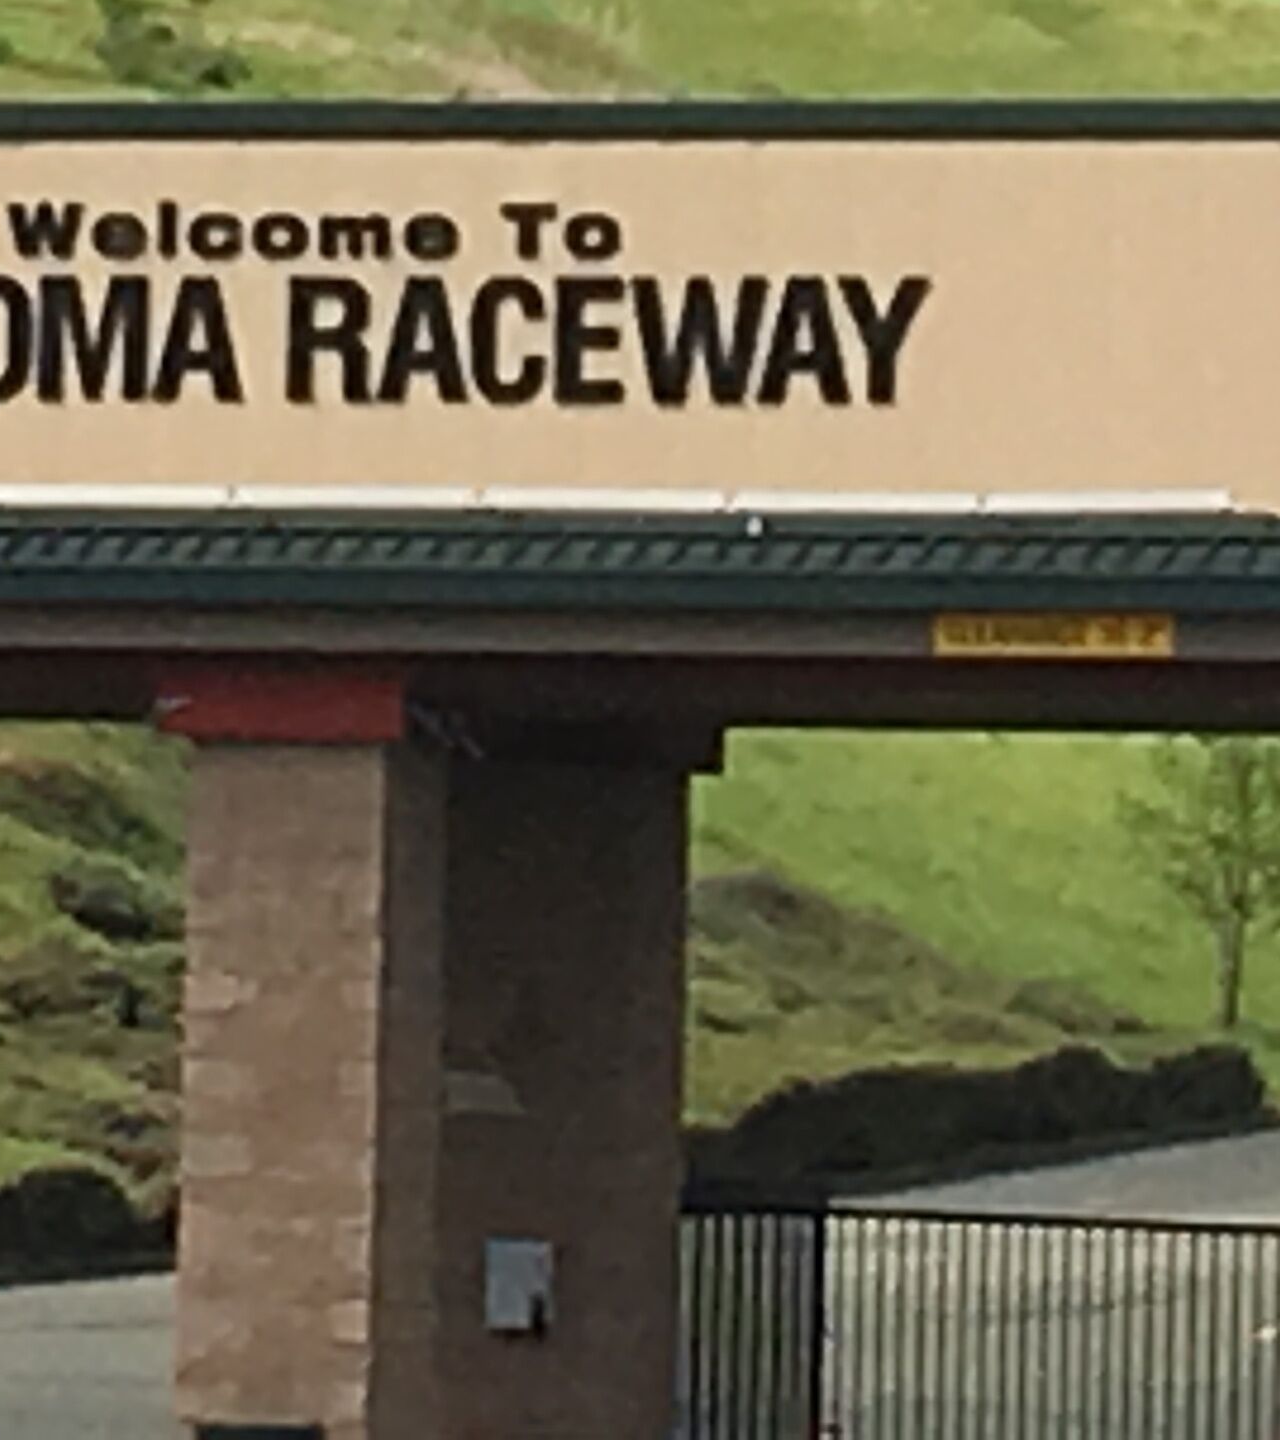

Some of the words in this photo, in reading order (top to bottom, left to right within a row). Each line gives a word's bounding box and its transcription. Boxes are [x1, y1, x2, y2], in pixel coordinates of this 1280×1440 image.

[6, 199, 461, 263] Welcome
[499, 202, 623, 262] To
[284, 274, 934, 410] RACEWAY
